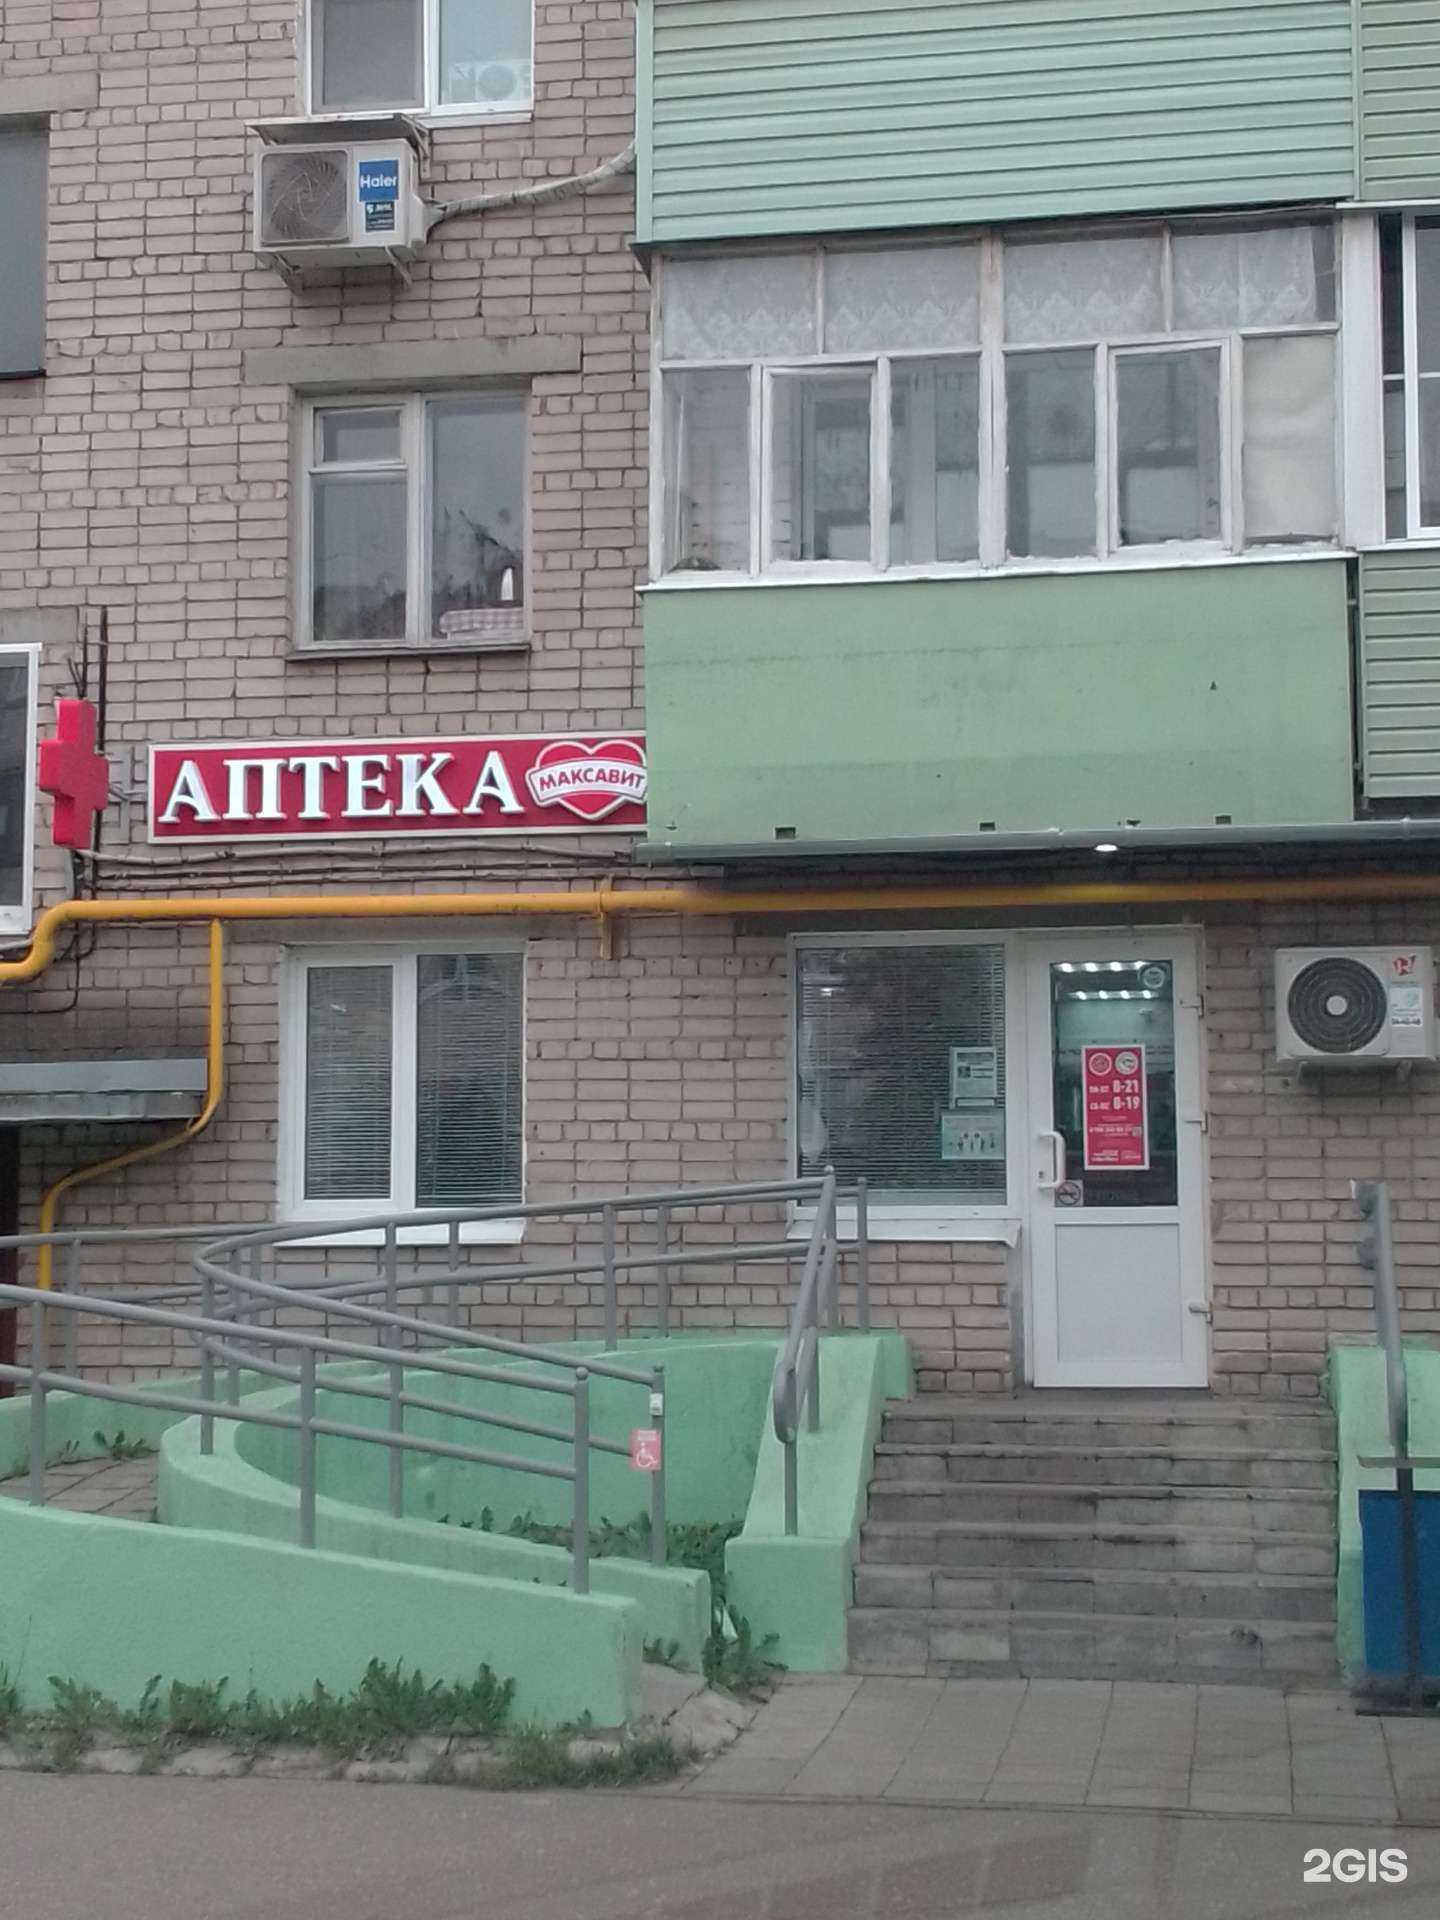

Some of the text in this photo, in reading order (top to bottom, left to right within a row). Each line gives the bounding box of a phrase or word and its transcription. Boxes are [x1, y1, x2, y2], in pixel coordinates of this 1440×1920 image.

[360, 174, 397, 188] Haier
[157, 750, 526, 824] АПТЕКА
[539, 767, 646, 792] МАКСАВИТ
